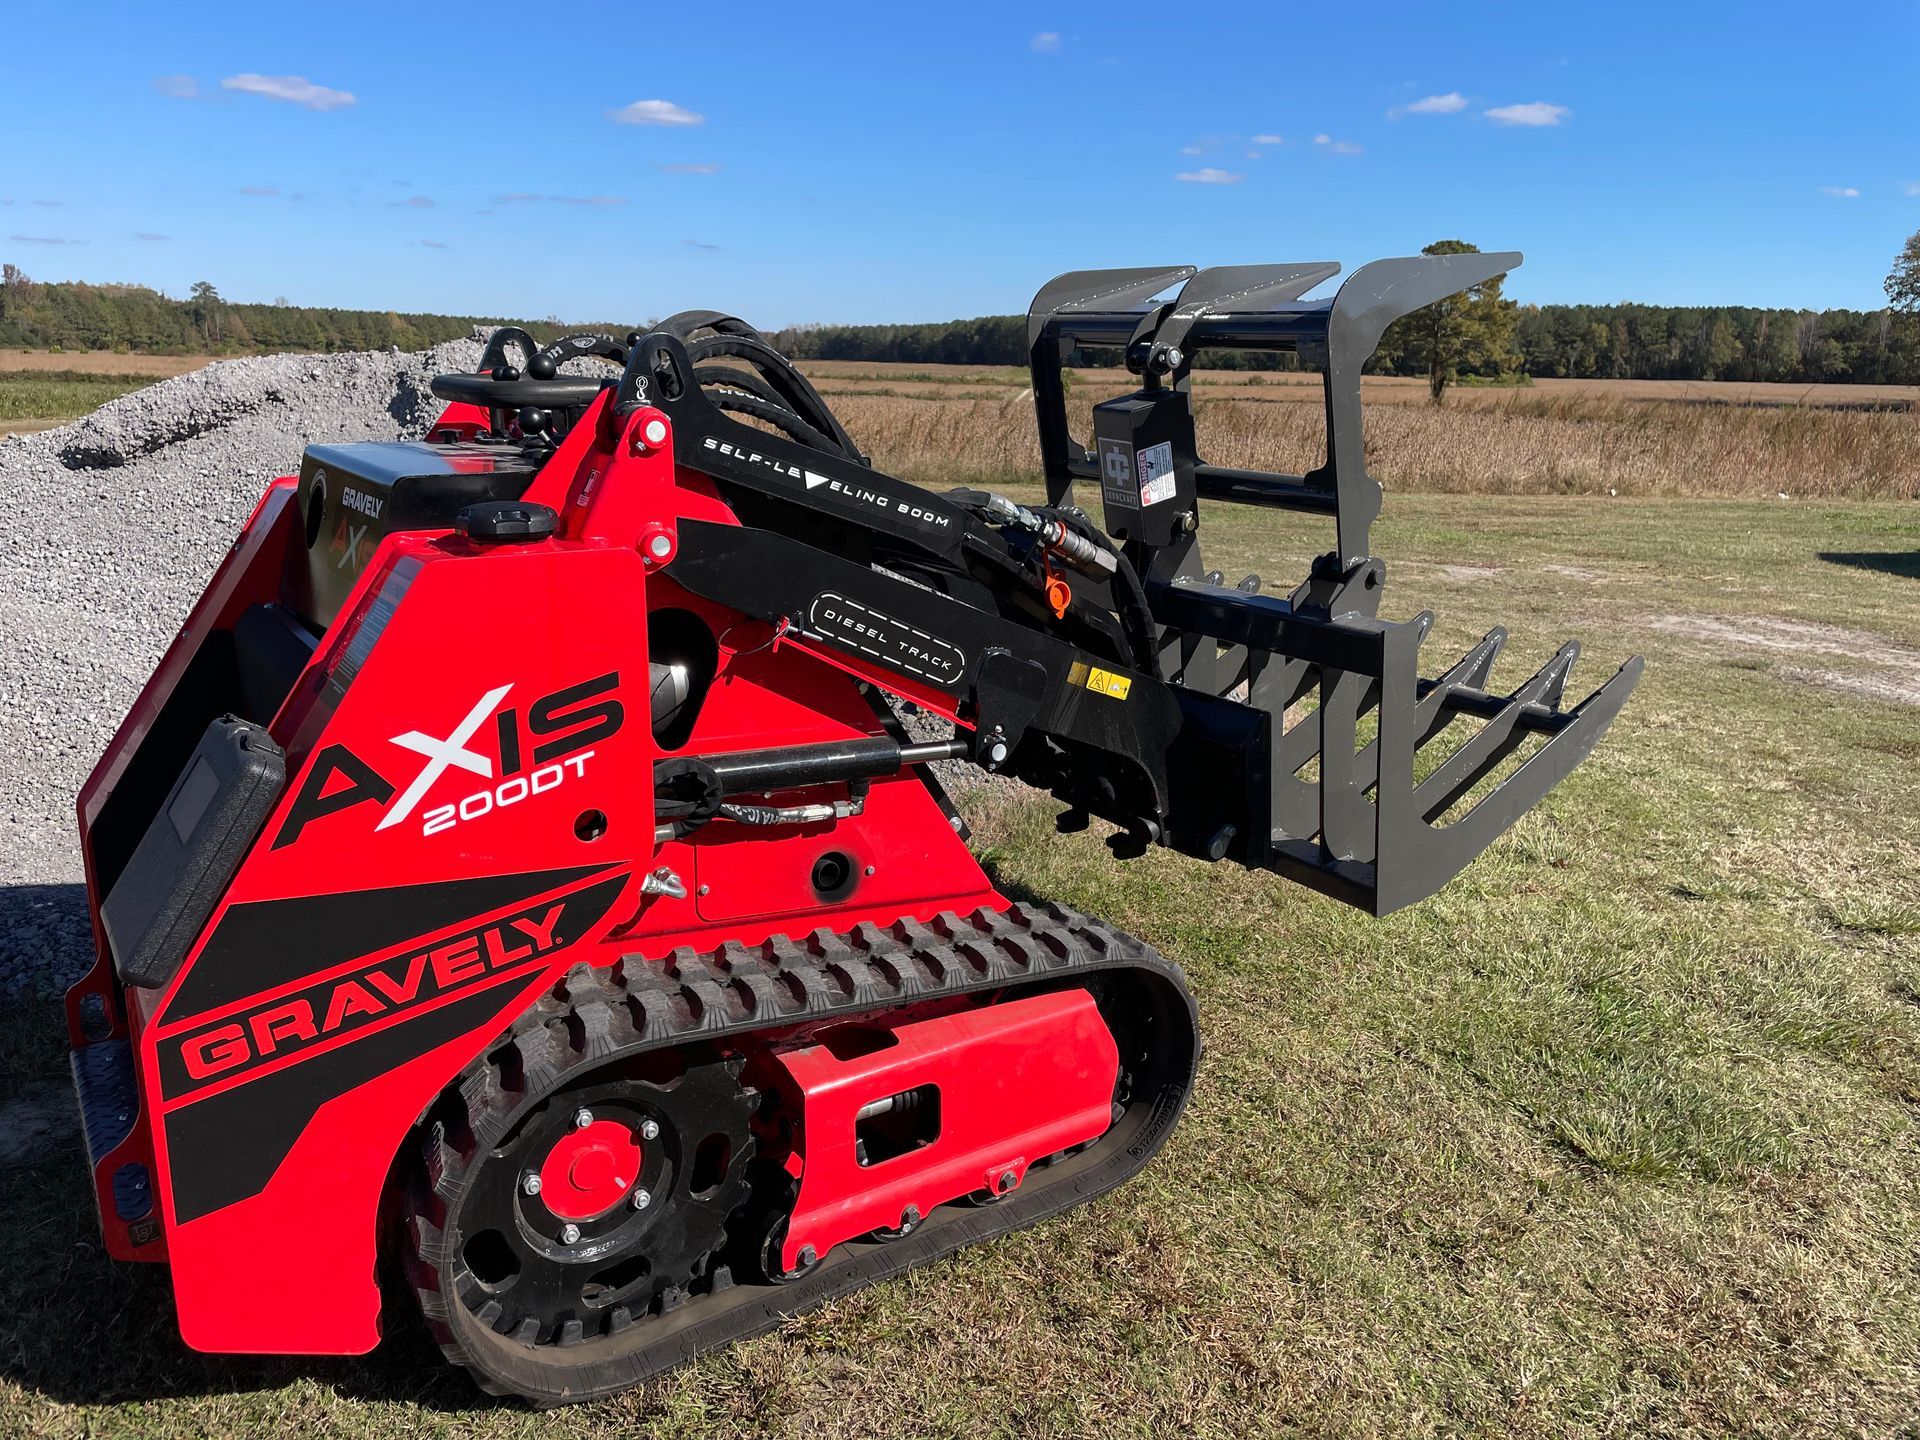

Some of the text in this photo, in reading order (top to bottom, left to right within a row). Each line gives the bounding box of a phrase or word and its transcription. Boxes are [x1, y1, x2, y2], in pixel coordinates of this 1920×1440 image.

[342, 486, 384, 519] GRAVELY
[1139, 454, 1149, 492] DANGER
[898, 503, 949, 527] BOOM
[824, 609, 952, 670] DIESEL TRACK
[269, 670, 625, 853] AXIS
[423, 750, 595, 837] 200DT
[180, 903, 566, 1080] GRAVELY
